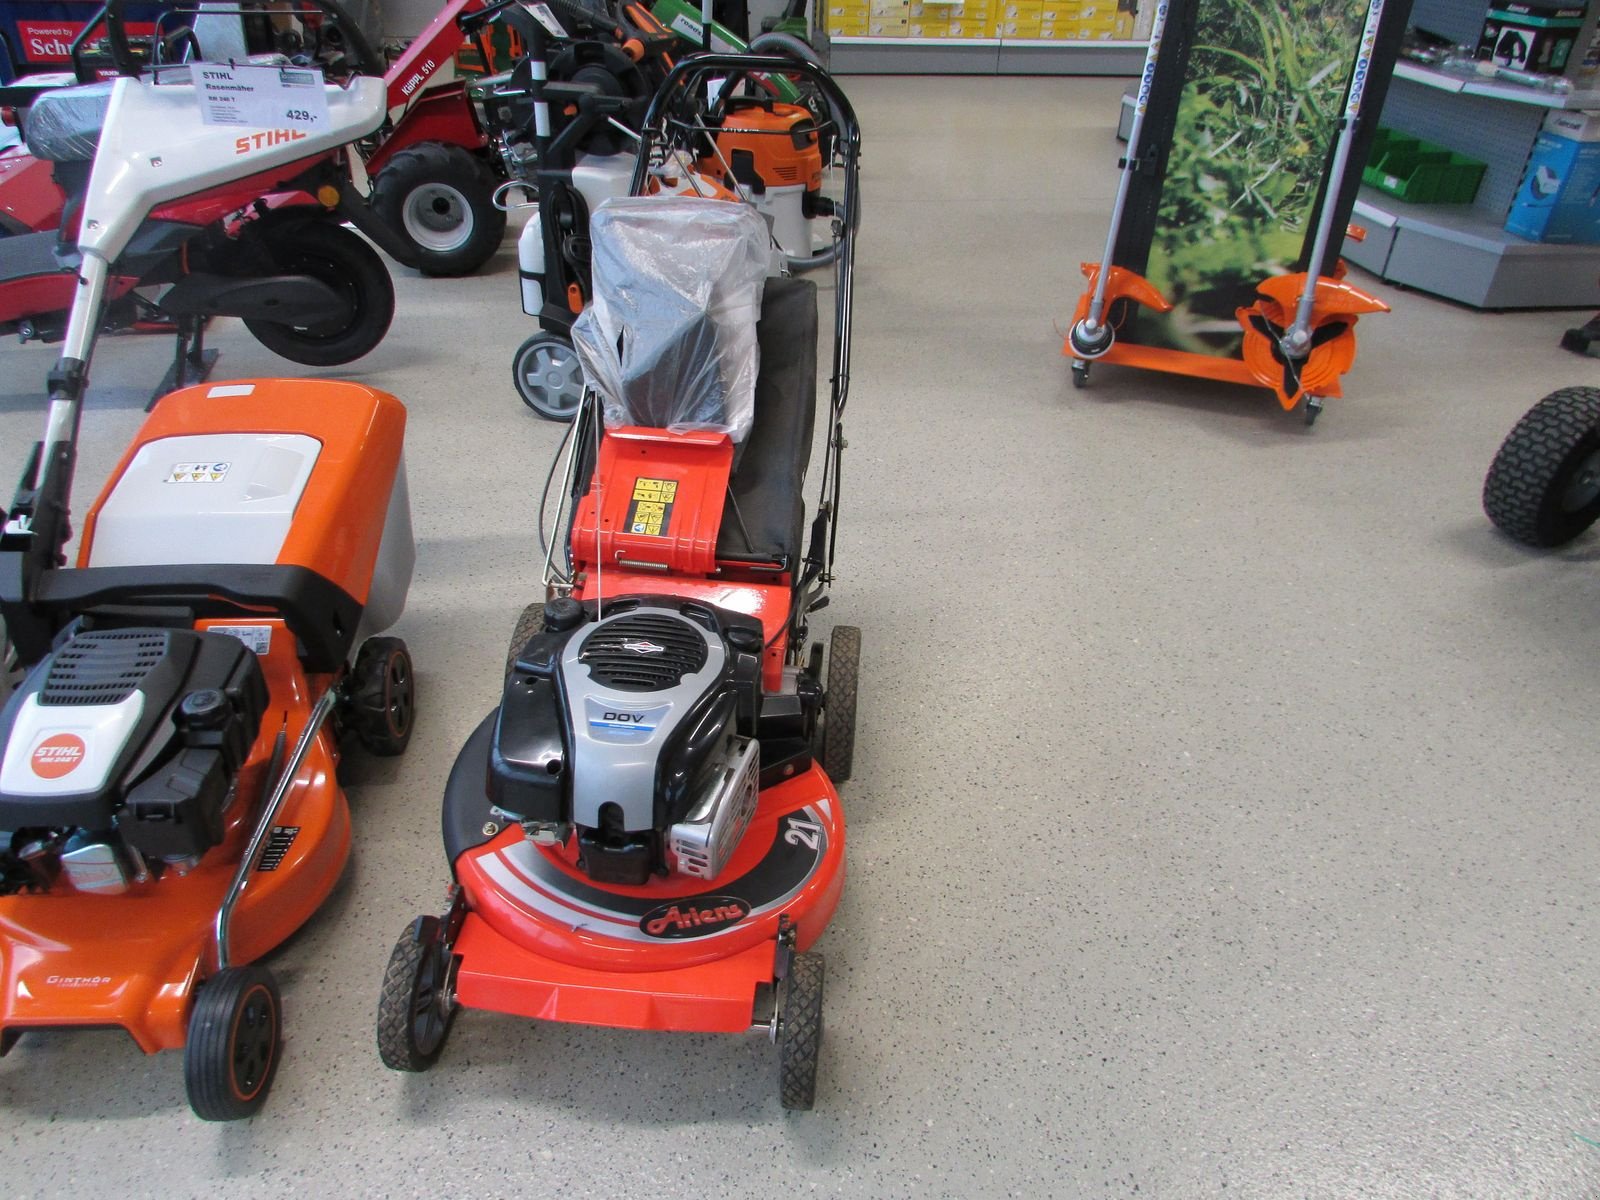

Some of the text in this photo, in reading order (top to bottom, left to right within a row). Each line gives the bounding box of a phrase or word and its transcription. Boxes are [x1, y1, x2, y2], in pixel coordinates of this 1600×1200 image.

[27, 27, 73, 36] Powered by
[421, 59, 436, 75] 510
[203, 71, 233, 80] STIHL
[206, 83, 254, 92] Rasenmäher
[286, 110, 318, 122] 429,-
[235, 128, 306, 154] STIHL
[603, 712, 645, 723] DOV
[35, 746, 81, 757] STIHL
[784, 817, 823, 850] 21
[647, 904, 743, 934] Ariens
